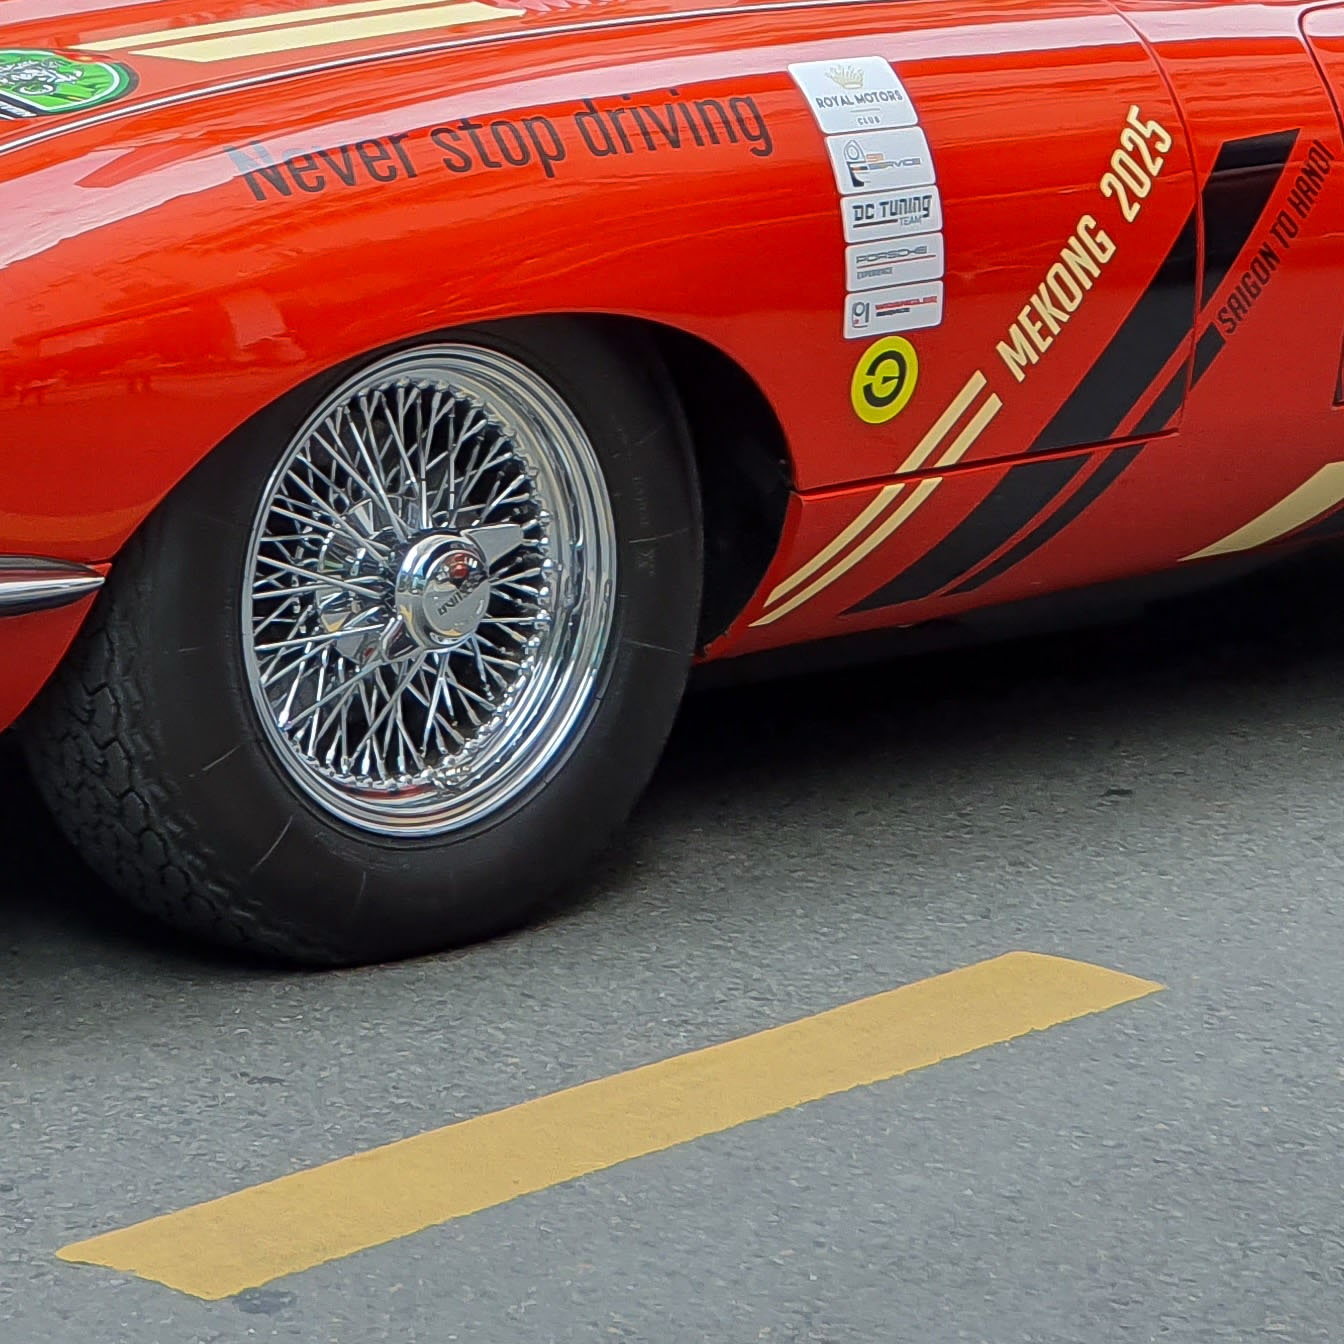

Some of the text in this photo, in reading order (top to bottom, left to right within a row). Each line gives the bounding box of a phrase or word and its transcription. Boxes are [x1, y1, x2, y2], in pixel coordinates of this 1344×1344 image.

[815, 89, 904, 109] ROYAL MOTORS
[857, 115, 881, 126] CLUB
[225, 88, 774, 201] Never stop driving
[852, 203, 875, 221] DC
[899, 216, 922, 226] TEAM
[995, 104, 1173, 383] MEKONG 2025
[1217, 139, 1335, 335] SAIGON TO HANOI
